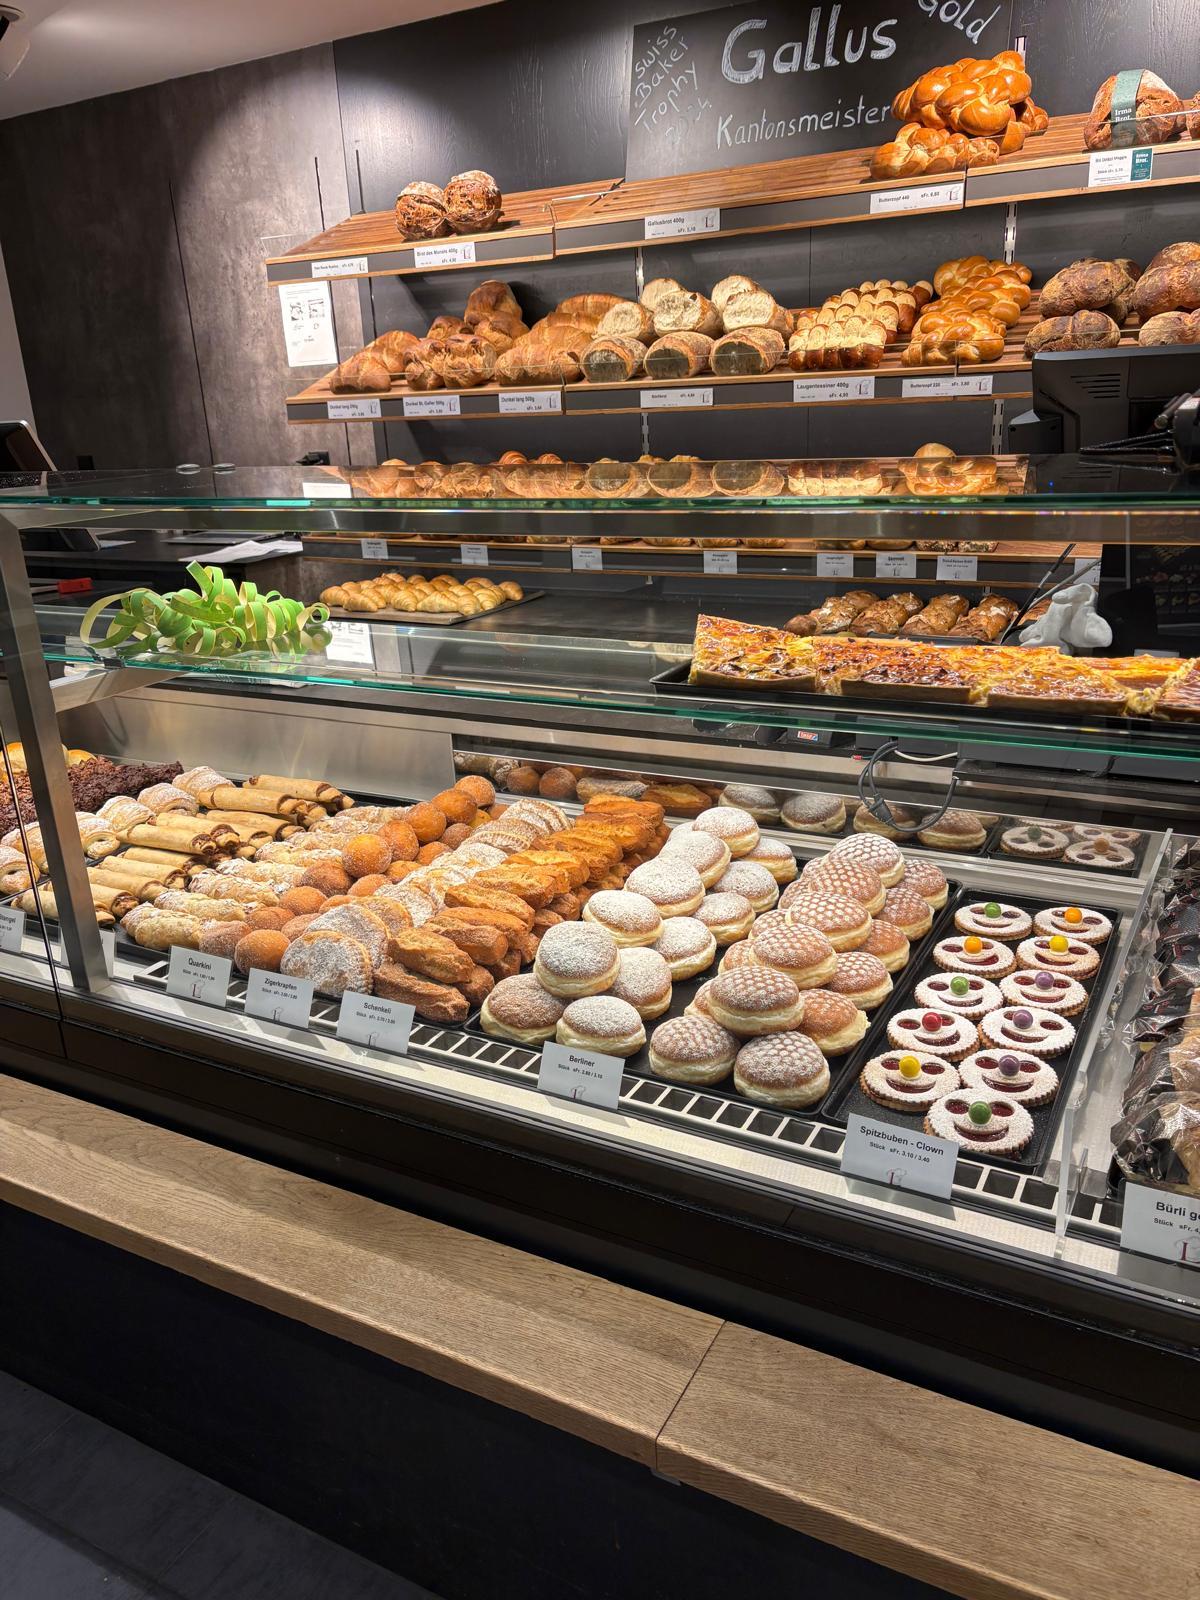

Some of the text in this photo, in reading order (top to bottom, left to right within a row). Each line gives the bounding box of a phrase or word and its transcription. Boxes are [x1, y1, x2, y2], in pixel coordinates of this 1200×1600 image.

[721, 4, 898, 84] Gallus
[635, 36, 688, 108] Baker
[634, 60, 698, 133] Trophy
[1115, 108, 1132, 116] Irma
[716, 96, 891, 150] Kantonsmeister
[648, 218, 673, 226] Gallusbrot
[796, 382, 835, 390] Laugentessiner
[188, 957, 212, 970] Quarkini
[264, 977, 298, 990] Zigerkrapfen
[363, 1002, 392, 1014] Schenkeli
[569, 1054, 595, 1067] Berliner
[859, 1125, 909, 1146] Spitzbuben
[916, 1141, 945, 1156] Clown
[869, 1141, 886, 1151] Stück
[889, 1147, 901, 1156] sFr.
[1156, 1201, 1186, 1217] Bürli
[1153, 1217, 1174, 1227] Stück
[1179, 1224, 1193, 1232] sFr.
